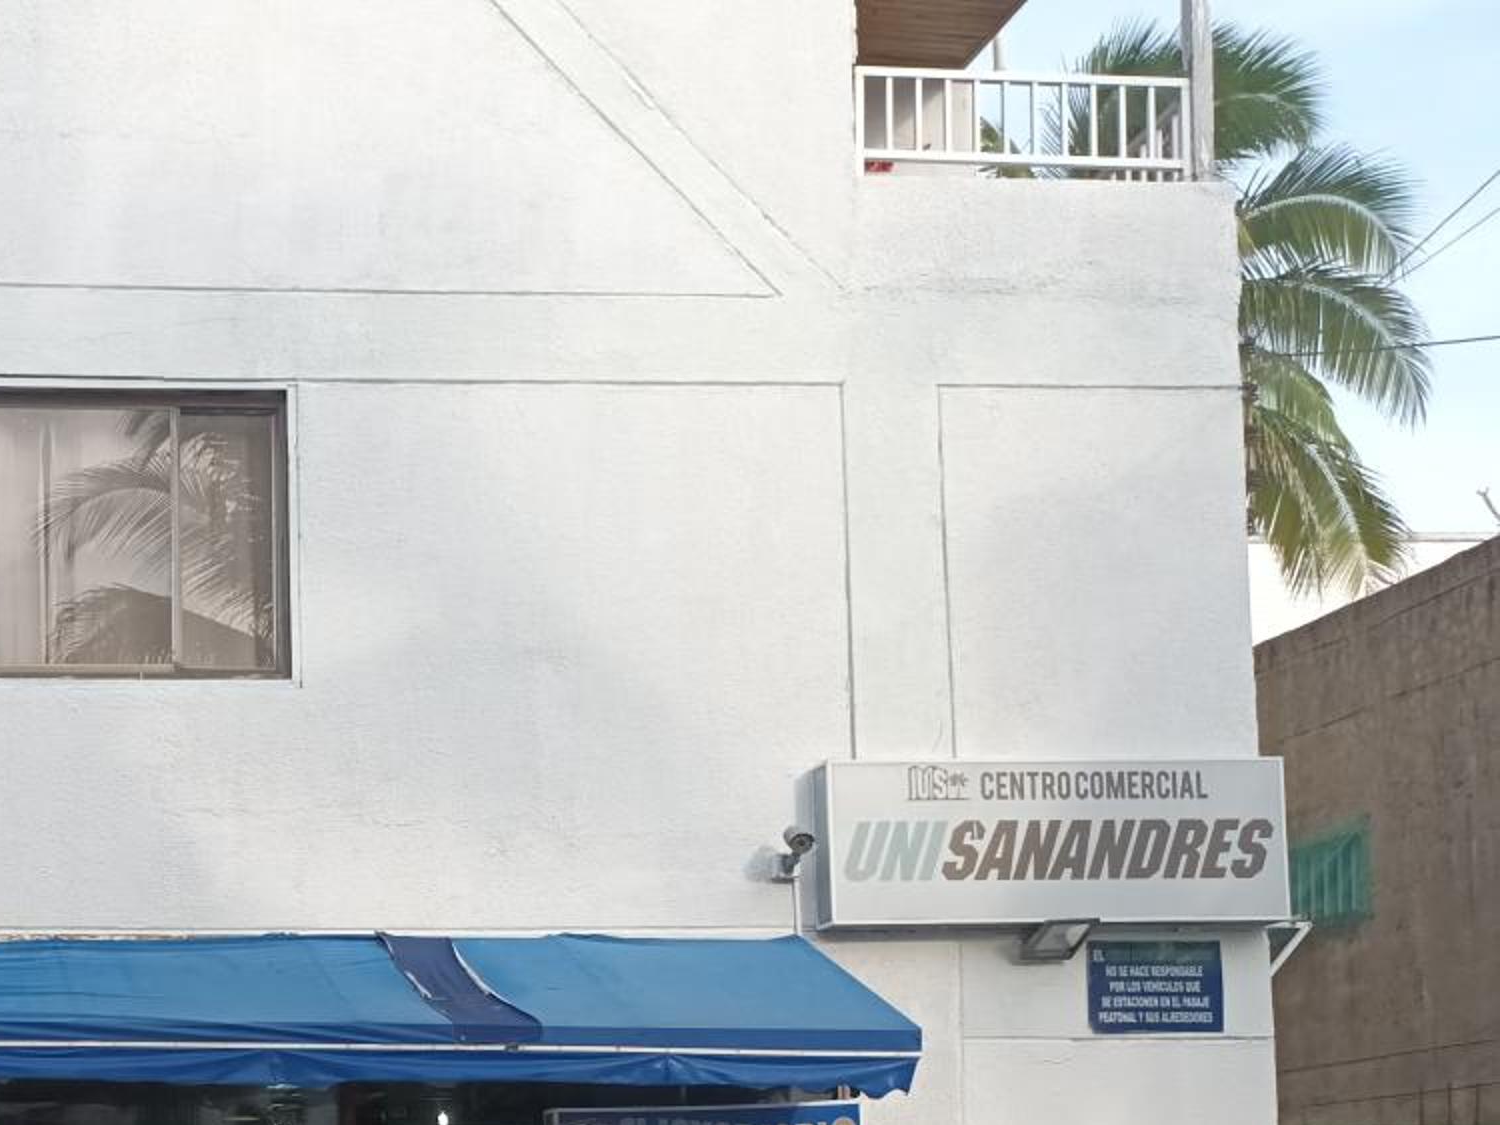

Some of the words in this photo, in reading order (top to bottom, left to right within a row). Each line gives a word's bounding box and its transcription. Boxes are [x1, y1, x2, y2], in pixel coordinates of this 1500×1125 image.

[1129, 965, 1150, 977] HACE
[1151, 965, 1203, 977] RESPONSABLE
[1109, 981, 1125, 993] POR
[1126, 981, 1141, 993] LOS
[1185, 981, 1201, 993] QUE
[1160, 996, 1171, 1008] EN
[1171, 996, 1181, 1008] EL
[1137, 1011, 1144, 1023] Y
